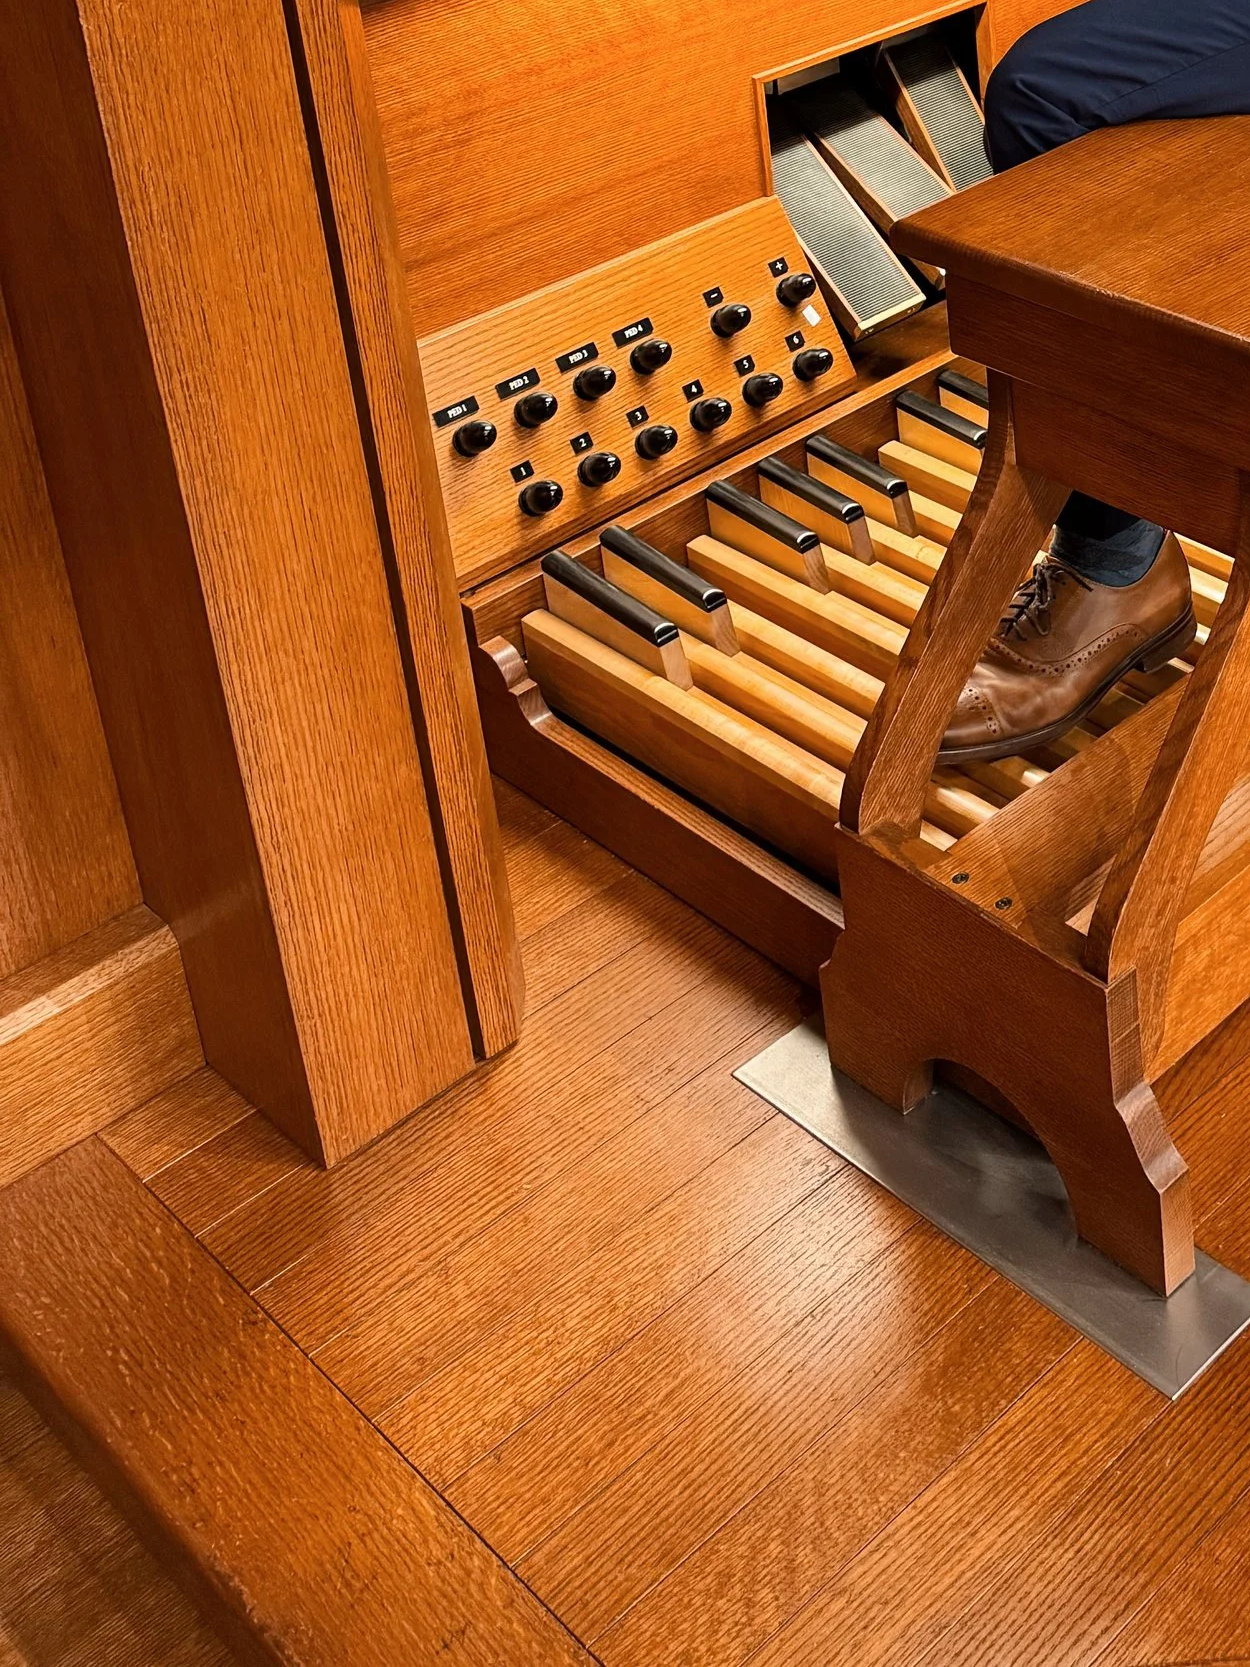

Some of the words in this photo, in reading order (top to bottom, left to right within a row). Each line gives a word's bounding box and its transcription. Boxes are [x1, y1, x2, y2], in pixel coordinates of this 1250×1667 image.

[624, 327, 638, 339] PED
[637, 324, 643, 332] 4
[792, 335, 799, 344] 6
[568, 352, 583, 364] PED
[582, 349, 588, 358] 3
[742, 360, 749, 369] 5
[508, 378, 524, 391] PED
[523, 375, 529, 384] 2
[691, 384, 698, 393] 4
[447, 405, 463, 418] PED
[461, 404, 467, 412] 1
[635, 411, 642, 420] 3
[579, 437, 587, 448] 2
[519, 467, 527, 476] 1
